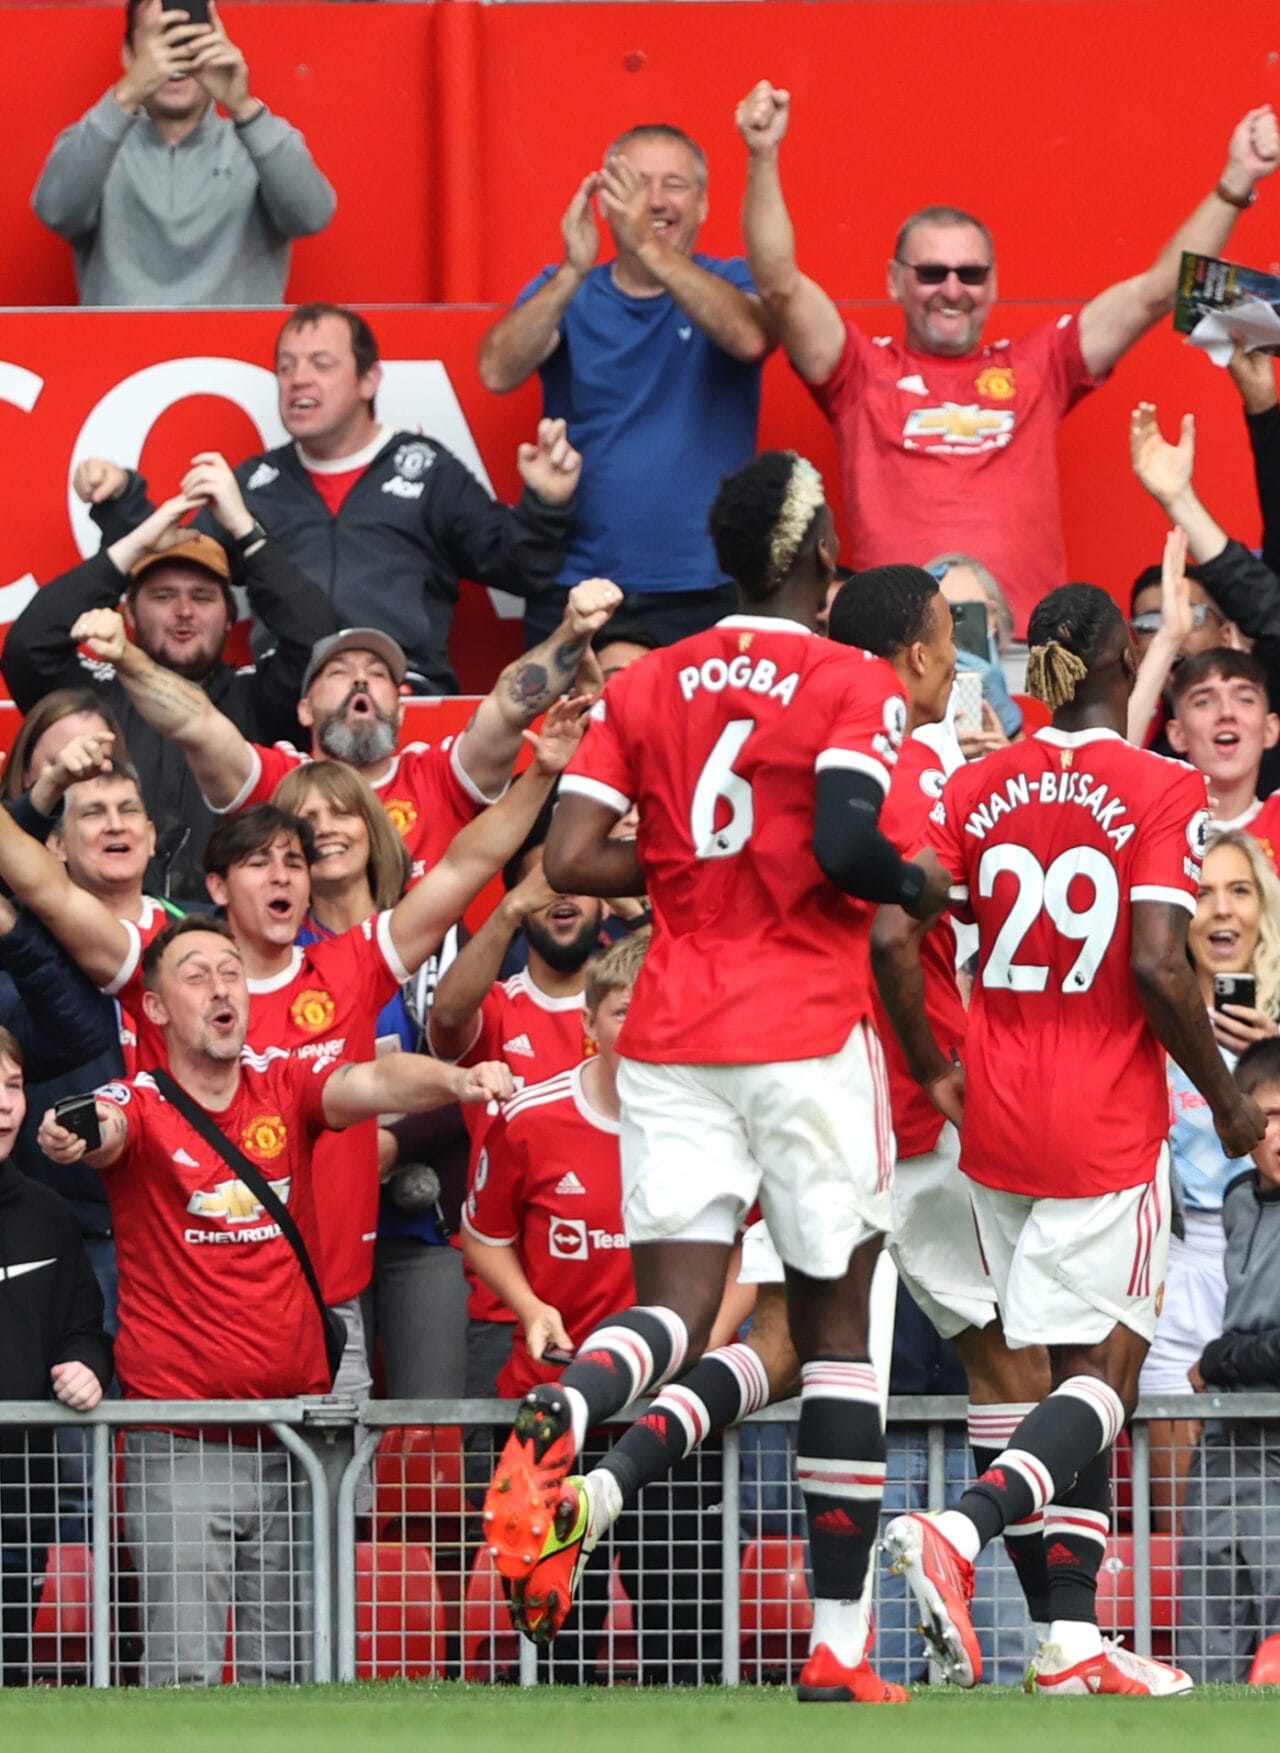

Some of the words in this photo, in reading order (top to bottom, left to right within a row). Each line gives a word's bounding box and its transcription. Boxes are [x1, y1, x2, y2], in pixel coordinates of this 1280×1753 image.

[679, 655, 800, 707] POGBA
[690, 718, 755, 860] 6
[965, 771, 1136, 851] WAN-BISSAKA
[978, 842, 1120, 994] 29
